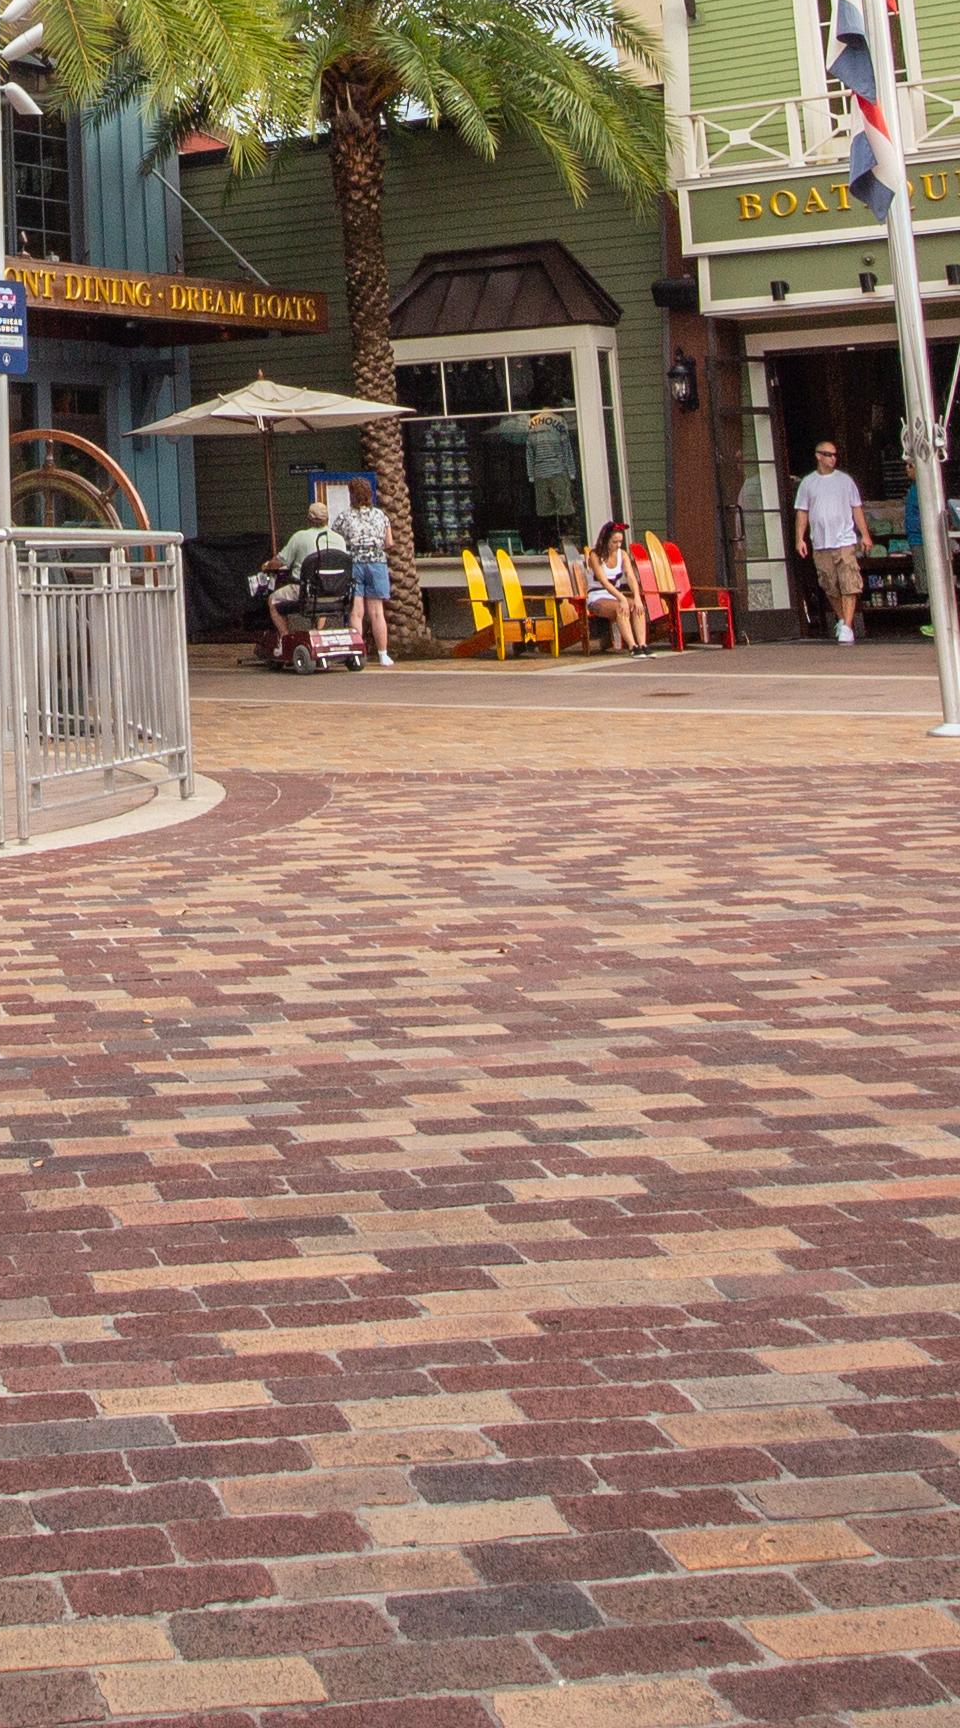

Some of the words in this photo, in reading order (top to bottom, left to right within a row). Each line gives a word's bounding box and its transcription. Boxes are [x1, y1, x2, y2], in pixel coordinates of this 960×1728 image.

[737, 170, 960, 221] BOATU
[64, 273, 151, 308] DINING
[170, 284, 246, 316] DREAM
[253, 292, 317, 322] BOATS
